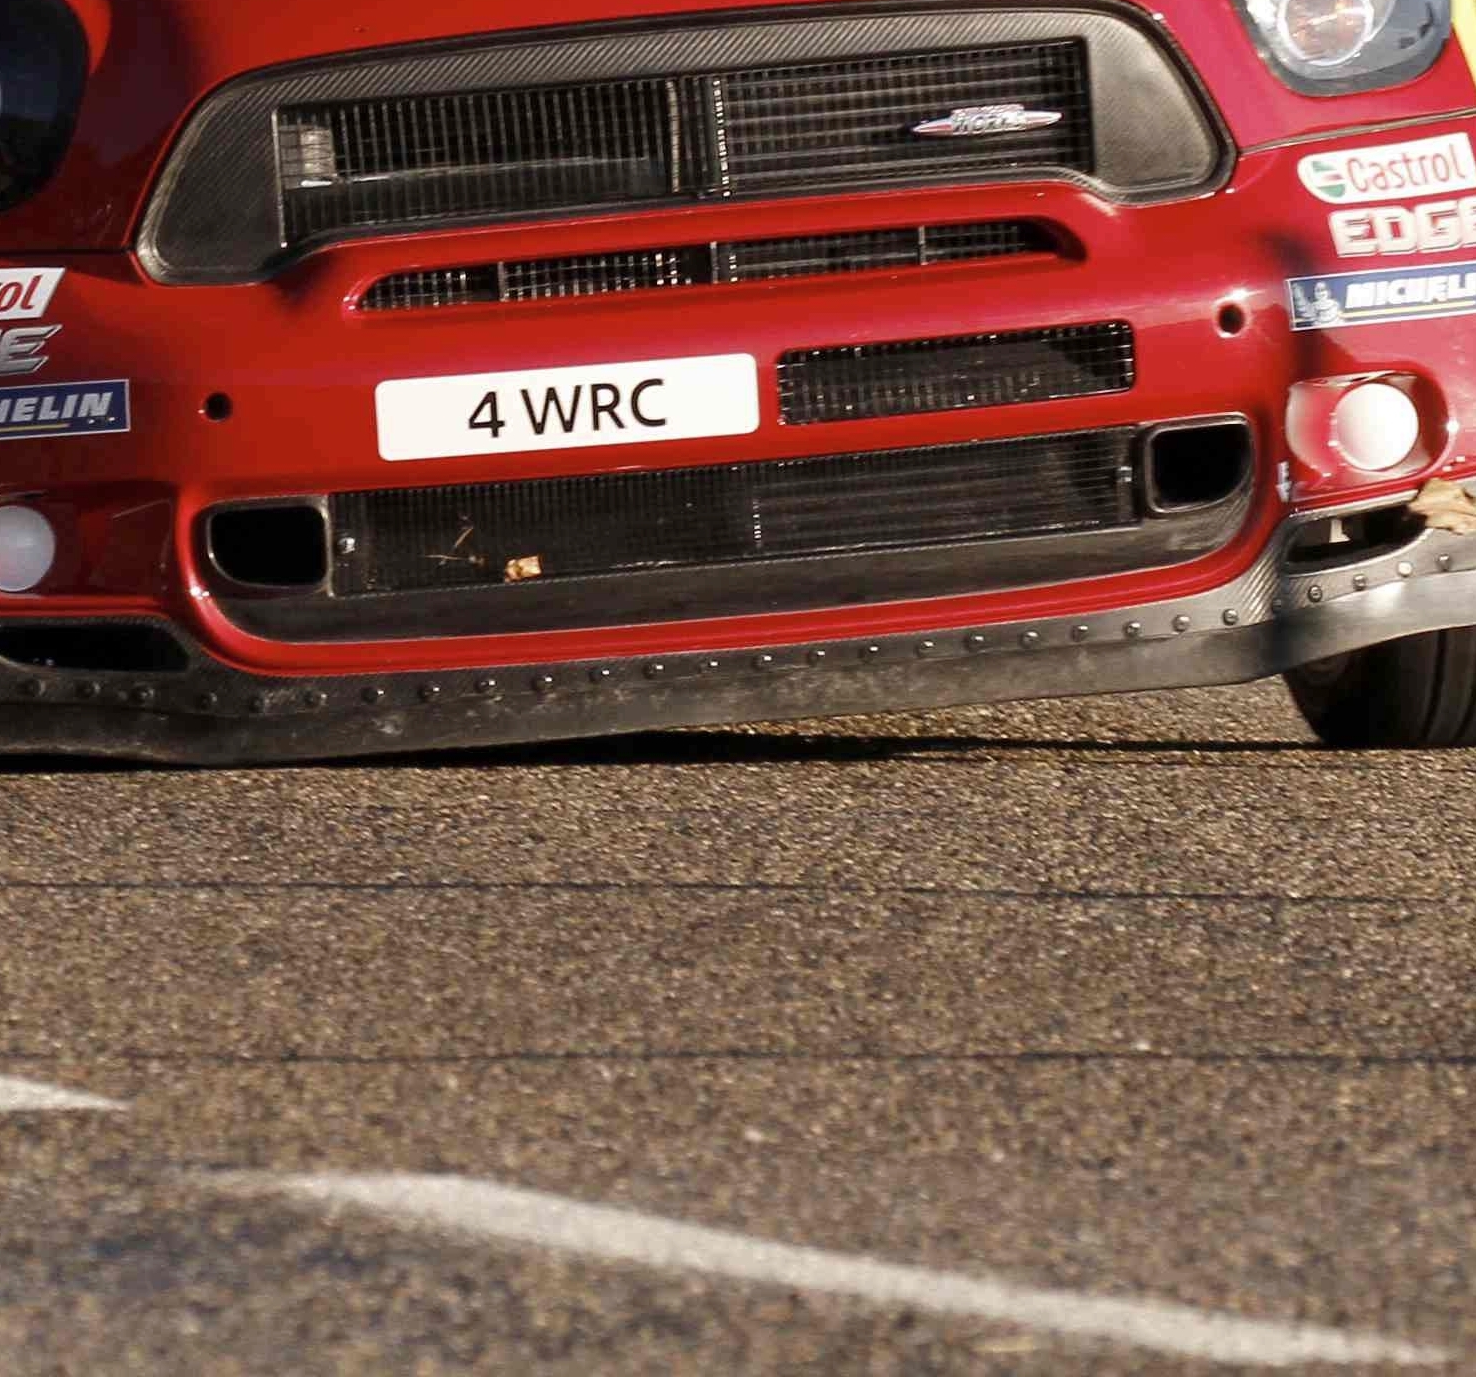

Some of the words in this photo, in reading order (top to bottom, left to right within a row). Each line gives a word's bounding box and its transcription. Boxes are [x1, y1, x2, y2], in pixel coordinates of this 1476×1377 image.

[1346, 143, 1466, 193] Castrol
[467, 390, 506, 439] 4
[520, 377, 668, 435] WRC
